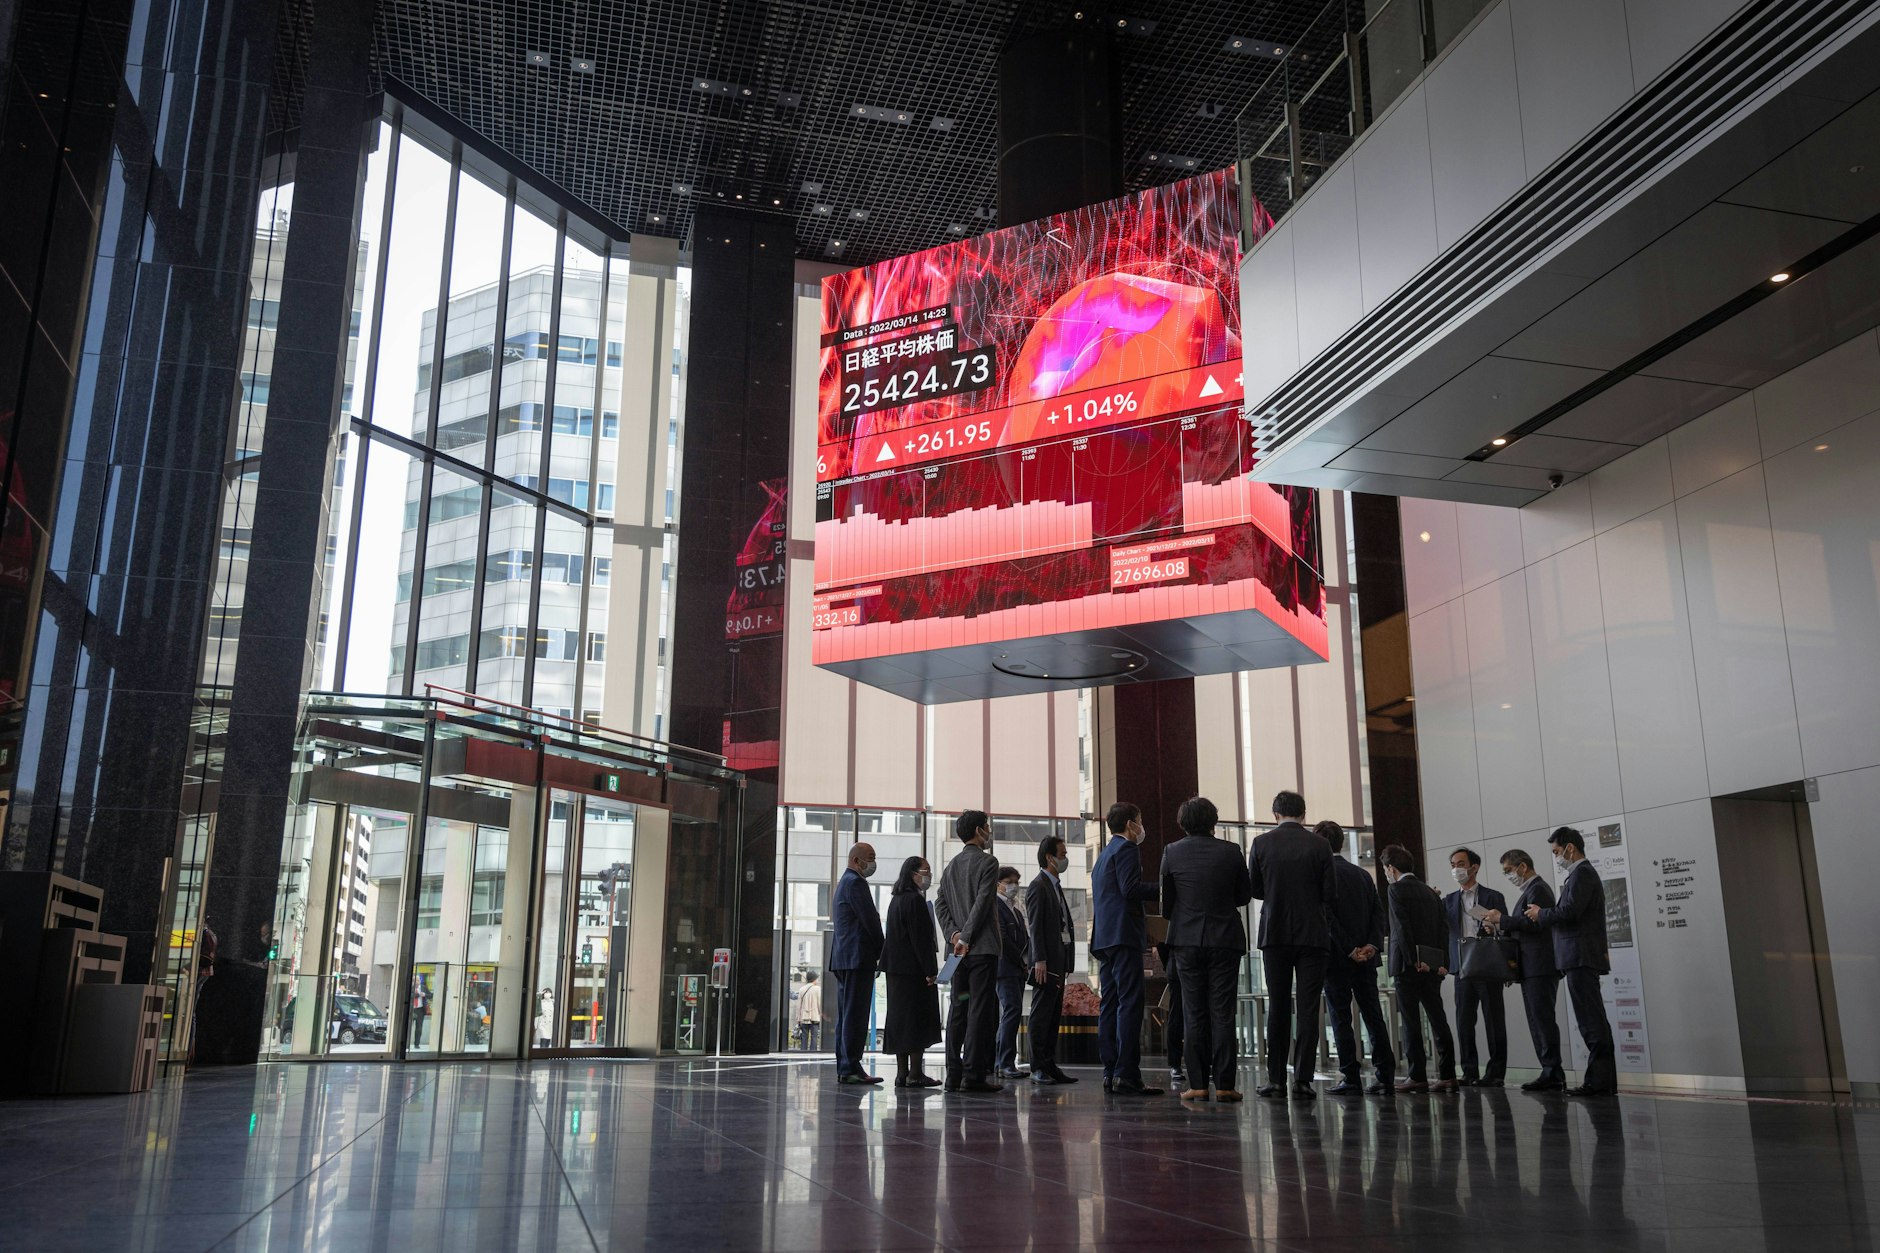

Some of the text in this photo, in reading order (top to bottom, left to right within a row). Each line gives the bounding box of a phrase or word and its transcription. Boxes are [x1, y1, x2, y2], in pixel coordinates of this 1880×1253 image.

[843, 329, 863, 341] Data
[869, 315, 918, 334] 2022/03/14
[923, 308, 947, 320] 14:23
[844, 329, 954, 373] 日経平均株価
[843, 354, 989, 412] 25424.73
[904, 391, 1137, 454] +261.95 +1.04%
[1114, 561, 1185, 584] 27696.08
[812, 610, 857, 627] 332.16
